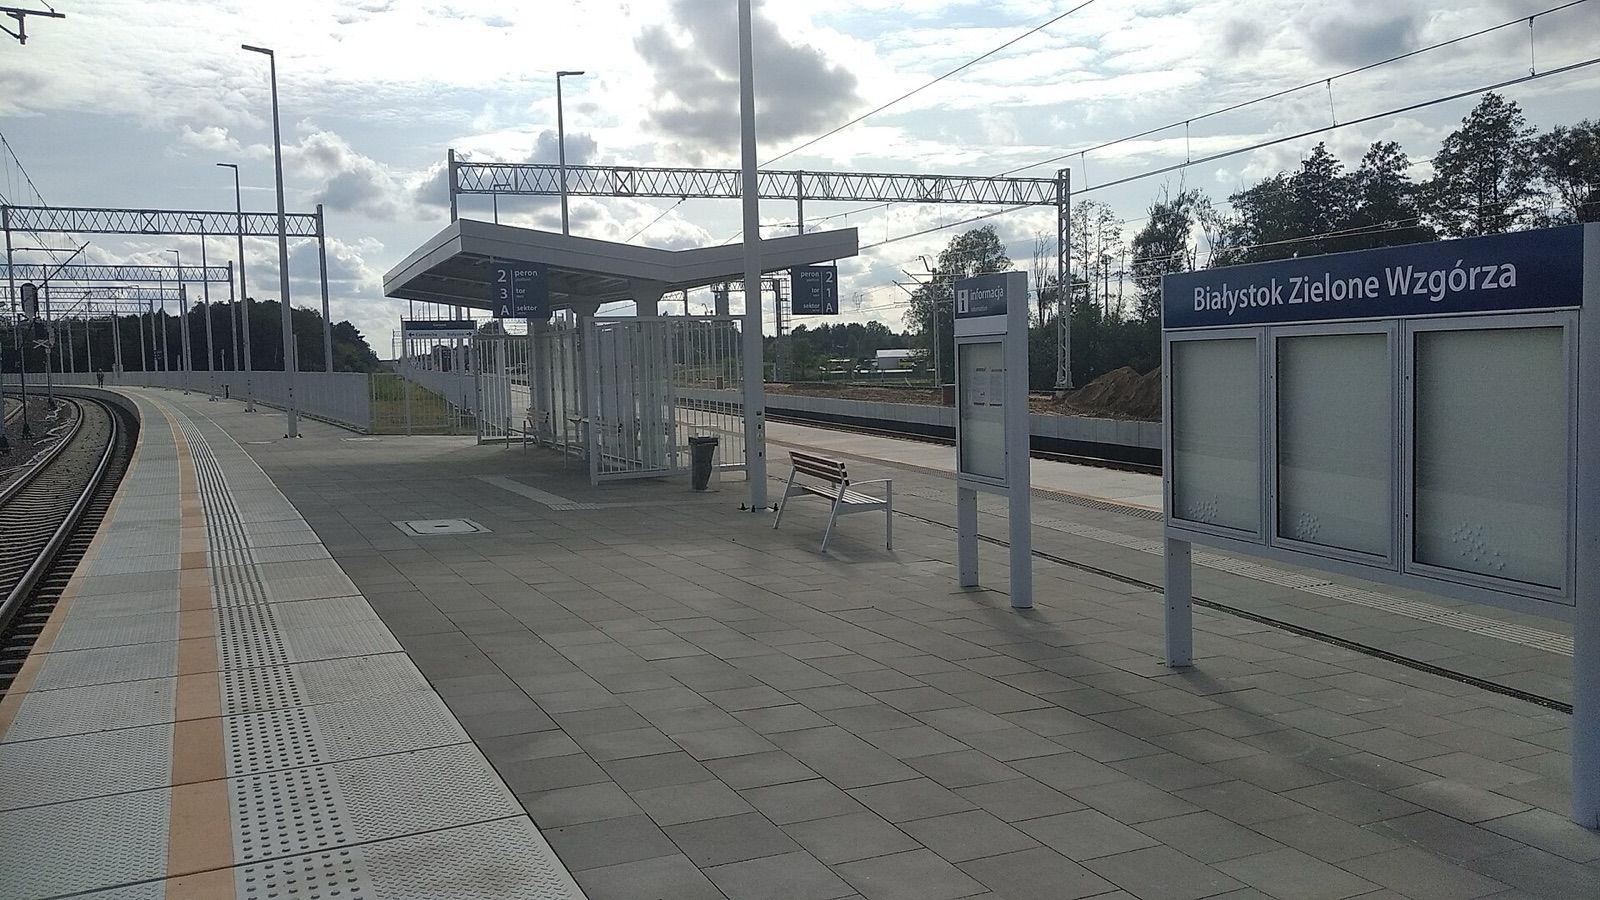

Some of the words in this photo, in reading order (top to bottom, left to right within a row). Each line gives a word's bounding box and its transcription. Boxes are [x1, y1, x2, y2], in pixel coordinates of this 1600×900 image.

[497, 269, 507, 283] 2
[514, 270, 538, 278] peron
[800, 271, 820, 279] peron
[825, 271, 833, 283] 2
[500, 288, 508, 299] 3
[826, 288, 831, 298] 1
[970, 285, 1004, 300] informacja
[1194, 278, 1283, 316] Białystok
[1288, 272, 1379, 304] Zielone
[1385, 259, 1517, 302] Wzgórza
[500, 304, 510, 316] A
[825, 302, 833, 313] A
